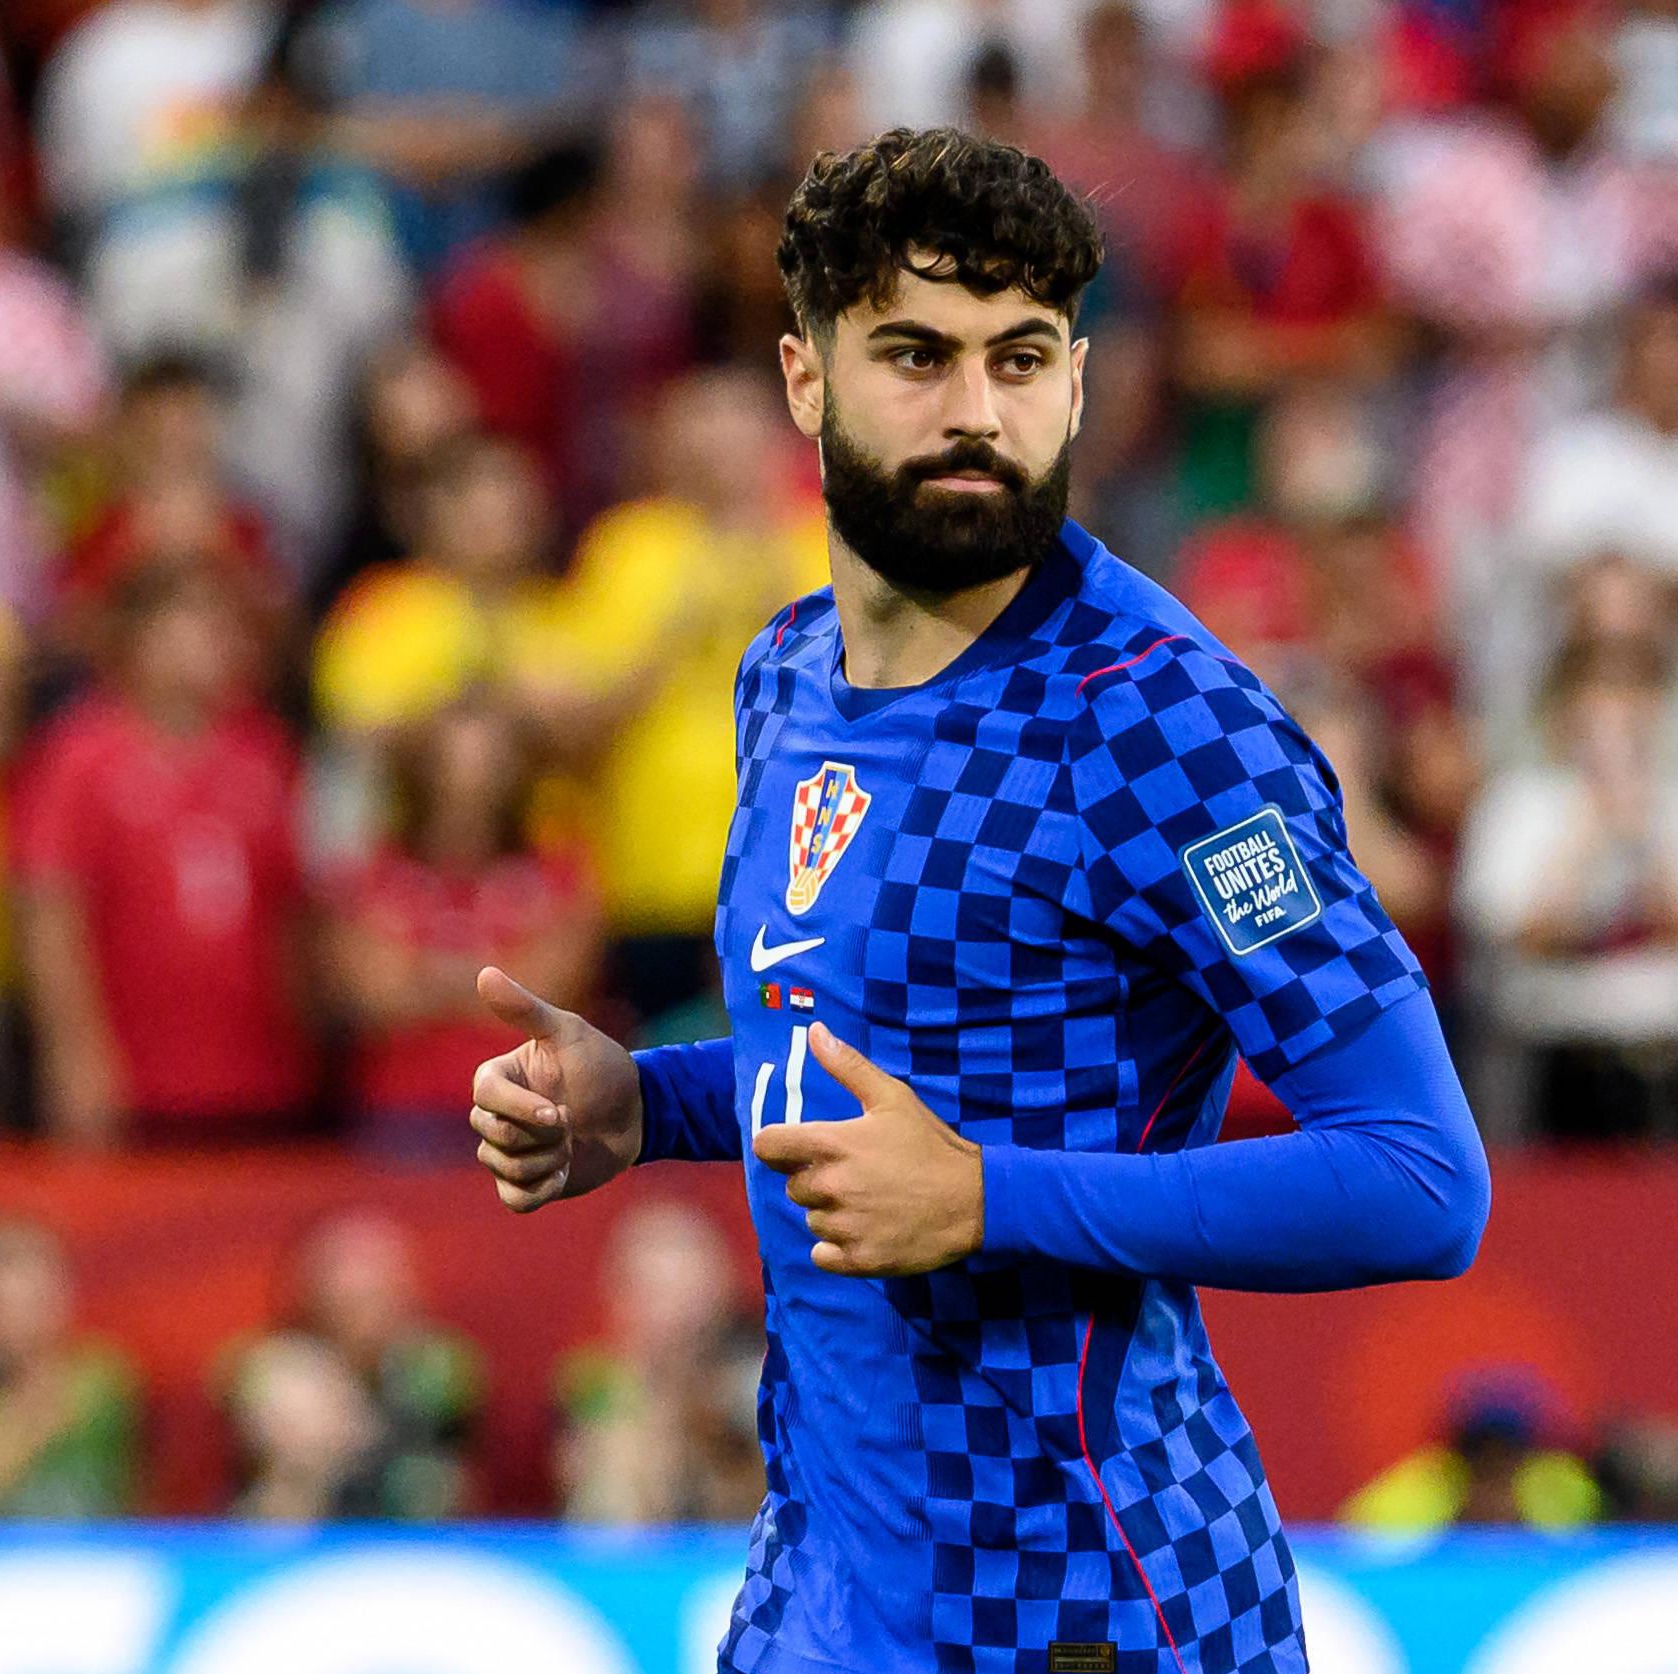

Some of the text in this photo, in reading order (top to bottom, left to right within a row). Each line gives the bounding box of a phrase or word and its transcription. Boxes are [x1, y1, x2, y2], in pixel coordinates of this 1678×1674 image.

[812, 779, 840, 854] HNS
[1203, 830, 1276, 876] FOOTBALL
[1212, 847, 1286, 900] UNITES
[1223, 869, 1299, 924] the World
[1254, 906, 1286, 928] FIFA
